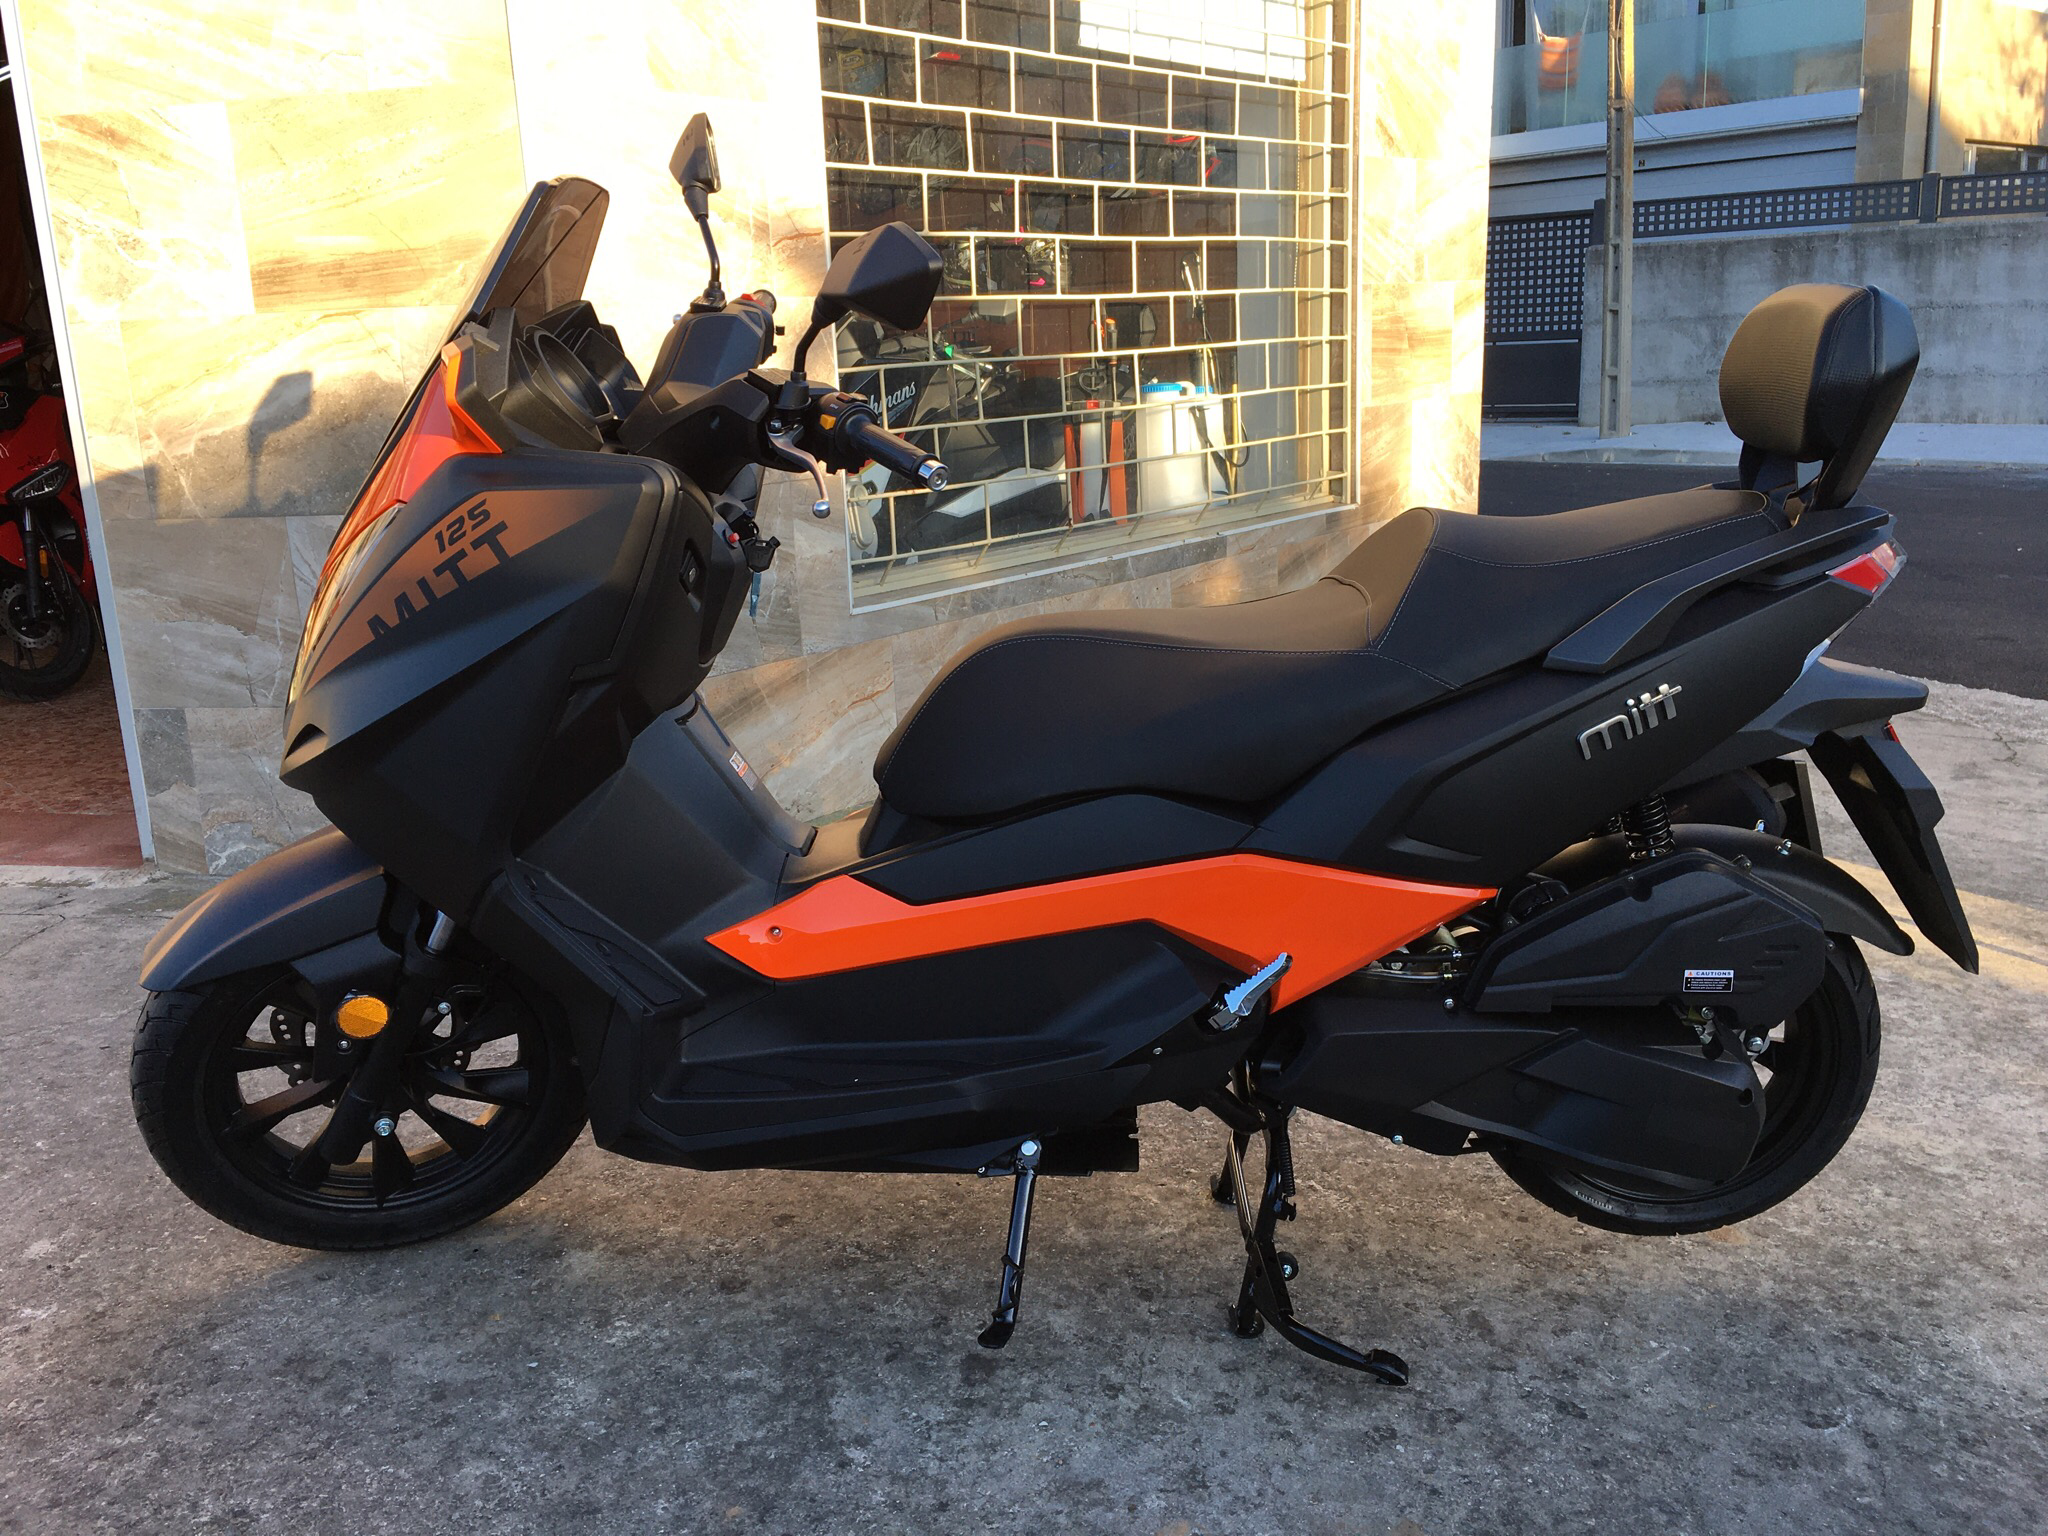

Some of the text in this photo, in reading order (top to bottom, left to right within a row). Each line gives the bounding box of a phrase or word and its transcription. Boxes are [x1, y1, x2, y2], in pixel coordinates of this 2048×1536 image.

[435, 498, 491, 554] 125
[367, 520, 511, 639] MITT
[1577, 683, 1683, 761] mitt
